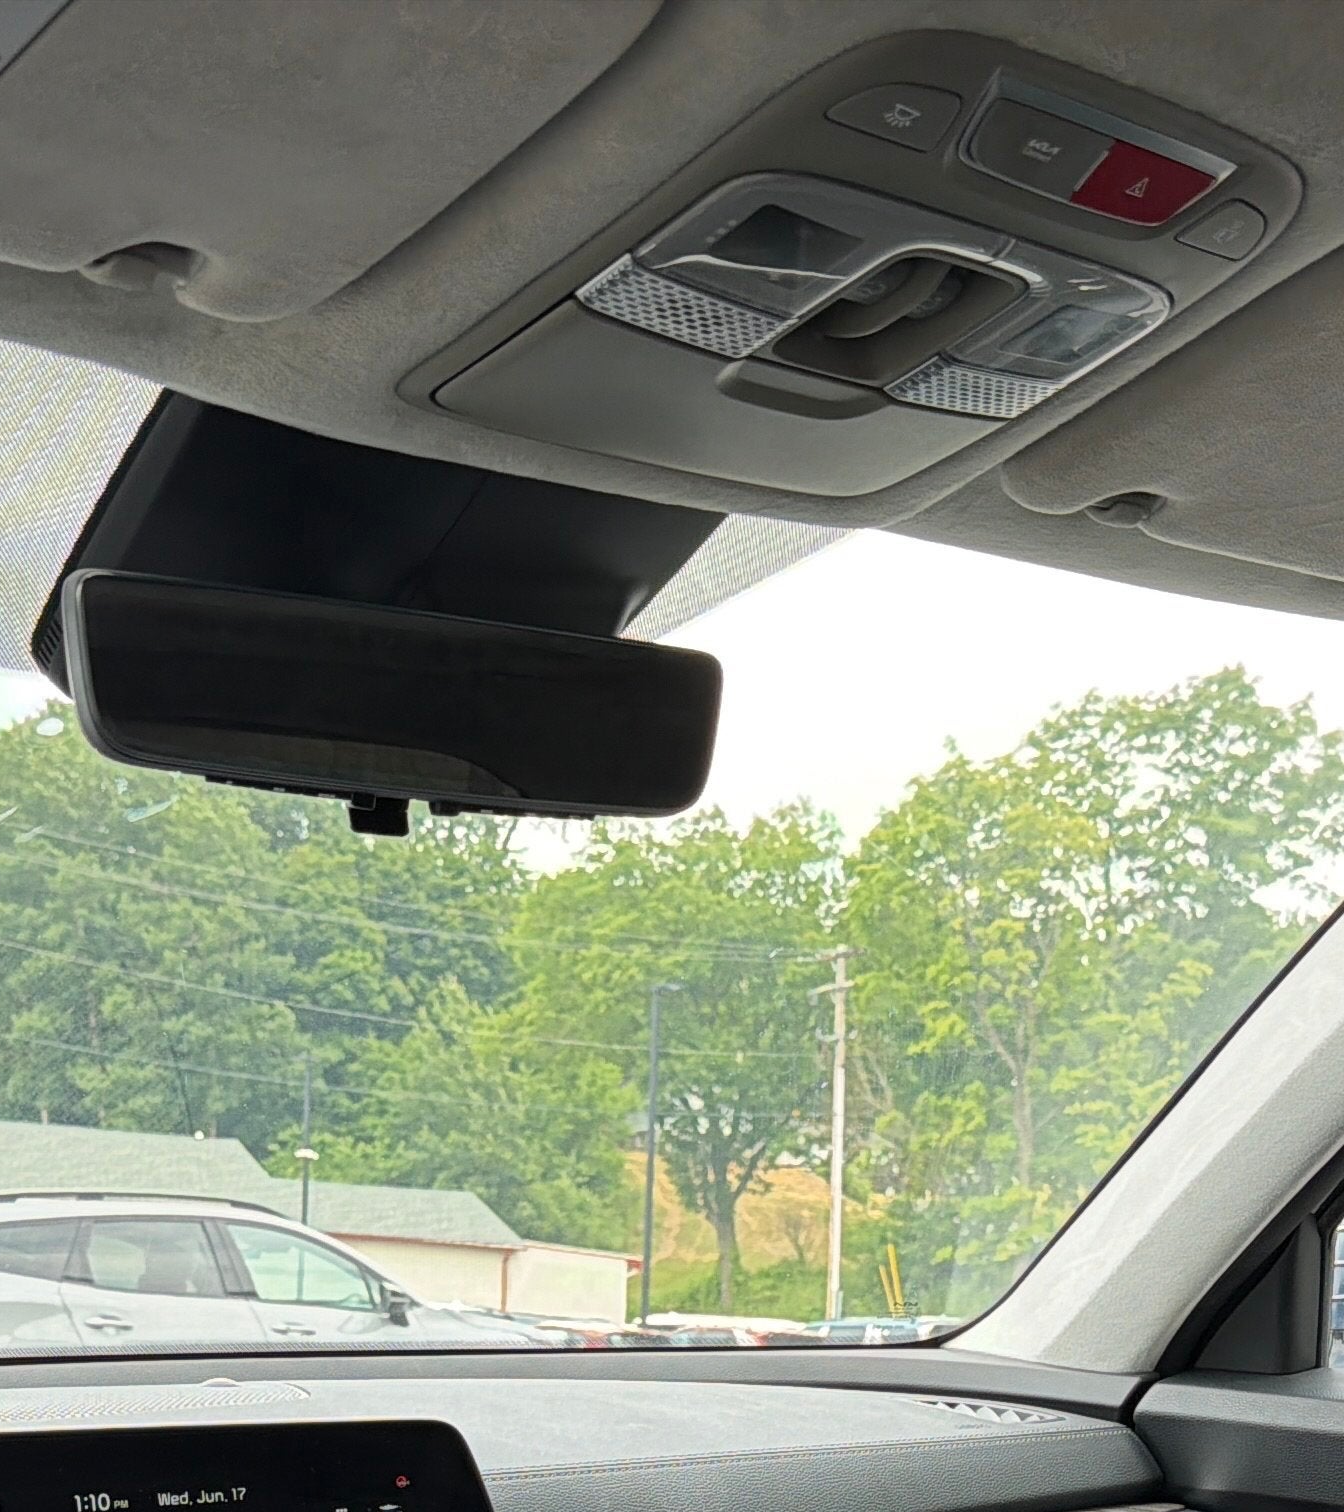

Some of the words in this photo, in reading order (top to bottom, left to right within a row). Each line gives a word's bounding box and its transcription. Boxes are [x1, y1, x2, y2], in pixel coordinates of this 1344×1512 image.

[73, 1493, 111, 1512] 1:10
[114, 1499, 129, 1509] PM
[157, 1491, 193, 1507] Wed,
[196, 1490, 228, 1504] Jun.
[231, 1487, 246, 1501] 17
